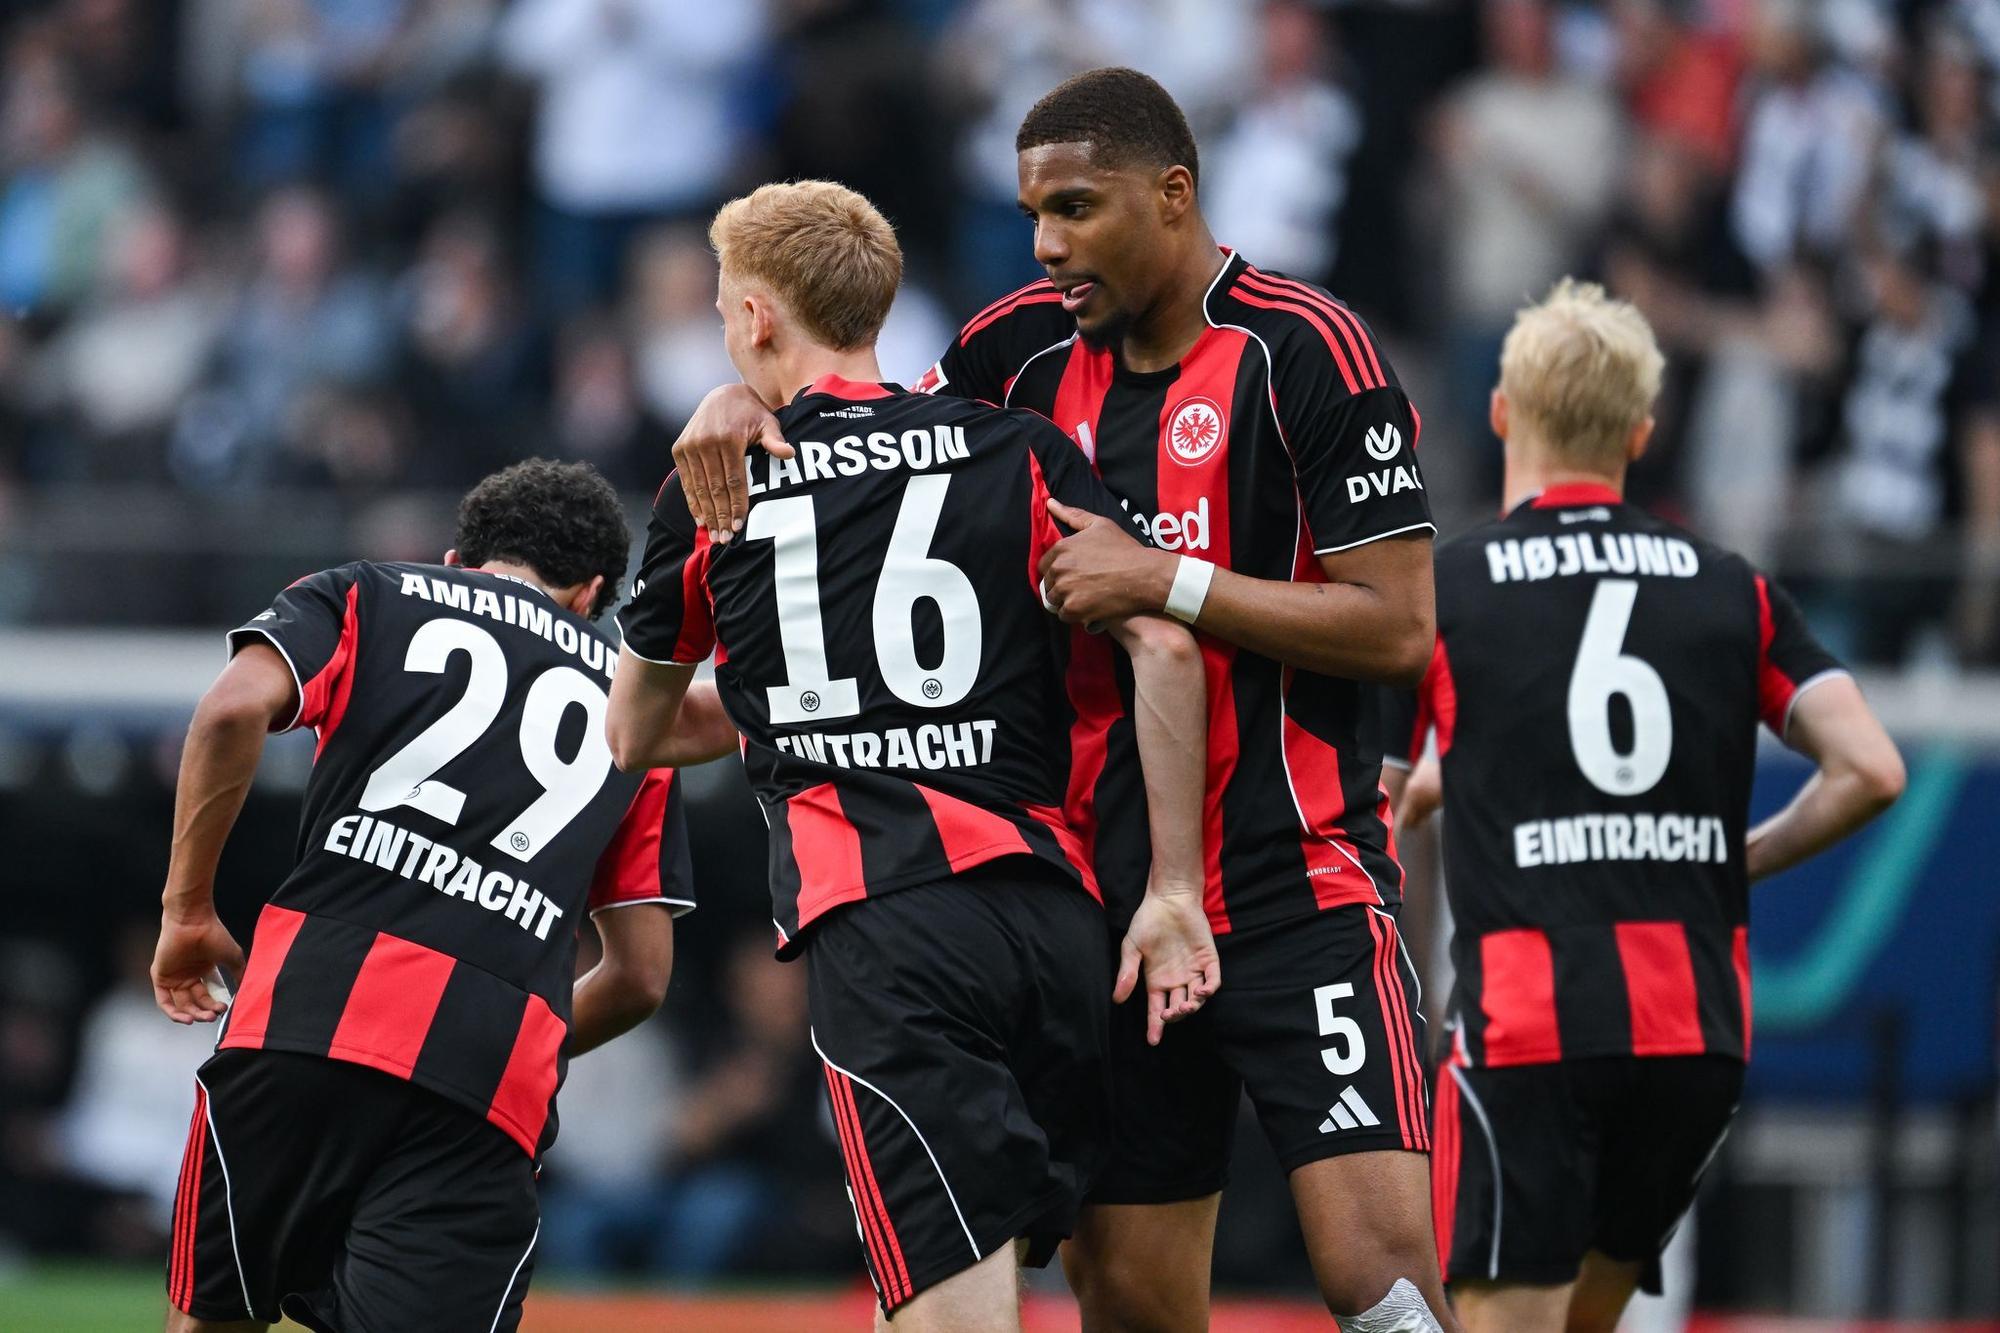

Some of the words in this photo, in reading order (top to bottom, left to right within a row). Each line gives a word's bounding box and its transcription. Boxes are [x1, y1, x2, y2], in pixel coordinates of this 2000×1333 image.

[745, 473, 983, 725] 16
[1485, 532, 1699, 584] HØJLUND
[357, 617, 612, 863] 29
[1568, 578, 1673, 796] 6
[323, 814, 563, 942] EINTRACHT
[1313, 981, 1367, 1076] 5
